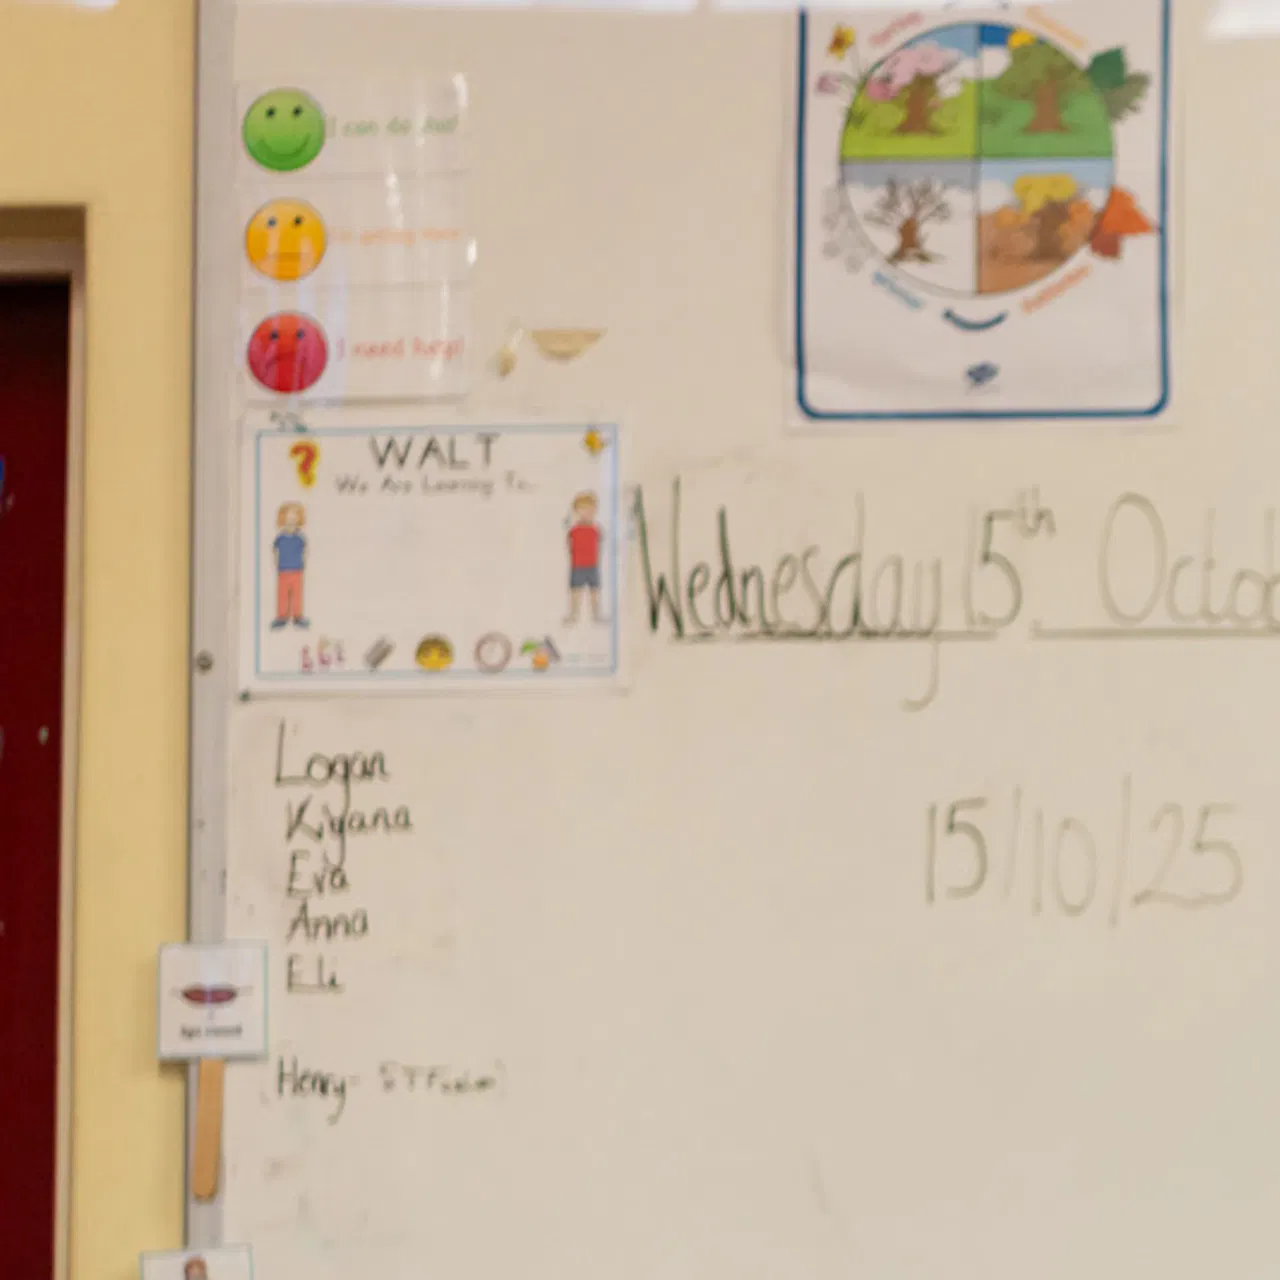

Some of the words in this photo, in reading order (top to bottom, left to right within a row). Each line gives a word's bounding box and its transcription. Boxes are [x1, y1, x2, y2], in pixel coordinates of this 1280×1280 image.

[366, 430, 502, 471] WALT
[334, 473, 369, 496] We
[632, 476, 942, 713] Wednesday
[274, 720, 390, 813] Logan
[285, 847, 350, 899] Eva
[922, 772, 1244, 928] 15/10/25
[286, 897, 369, 941] Anna
